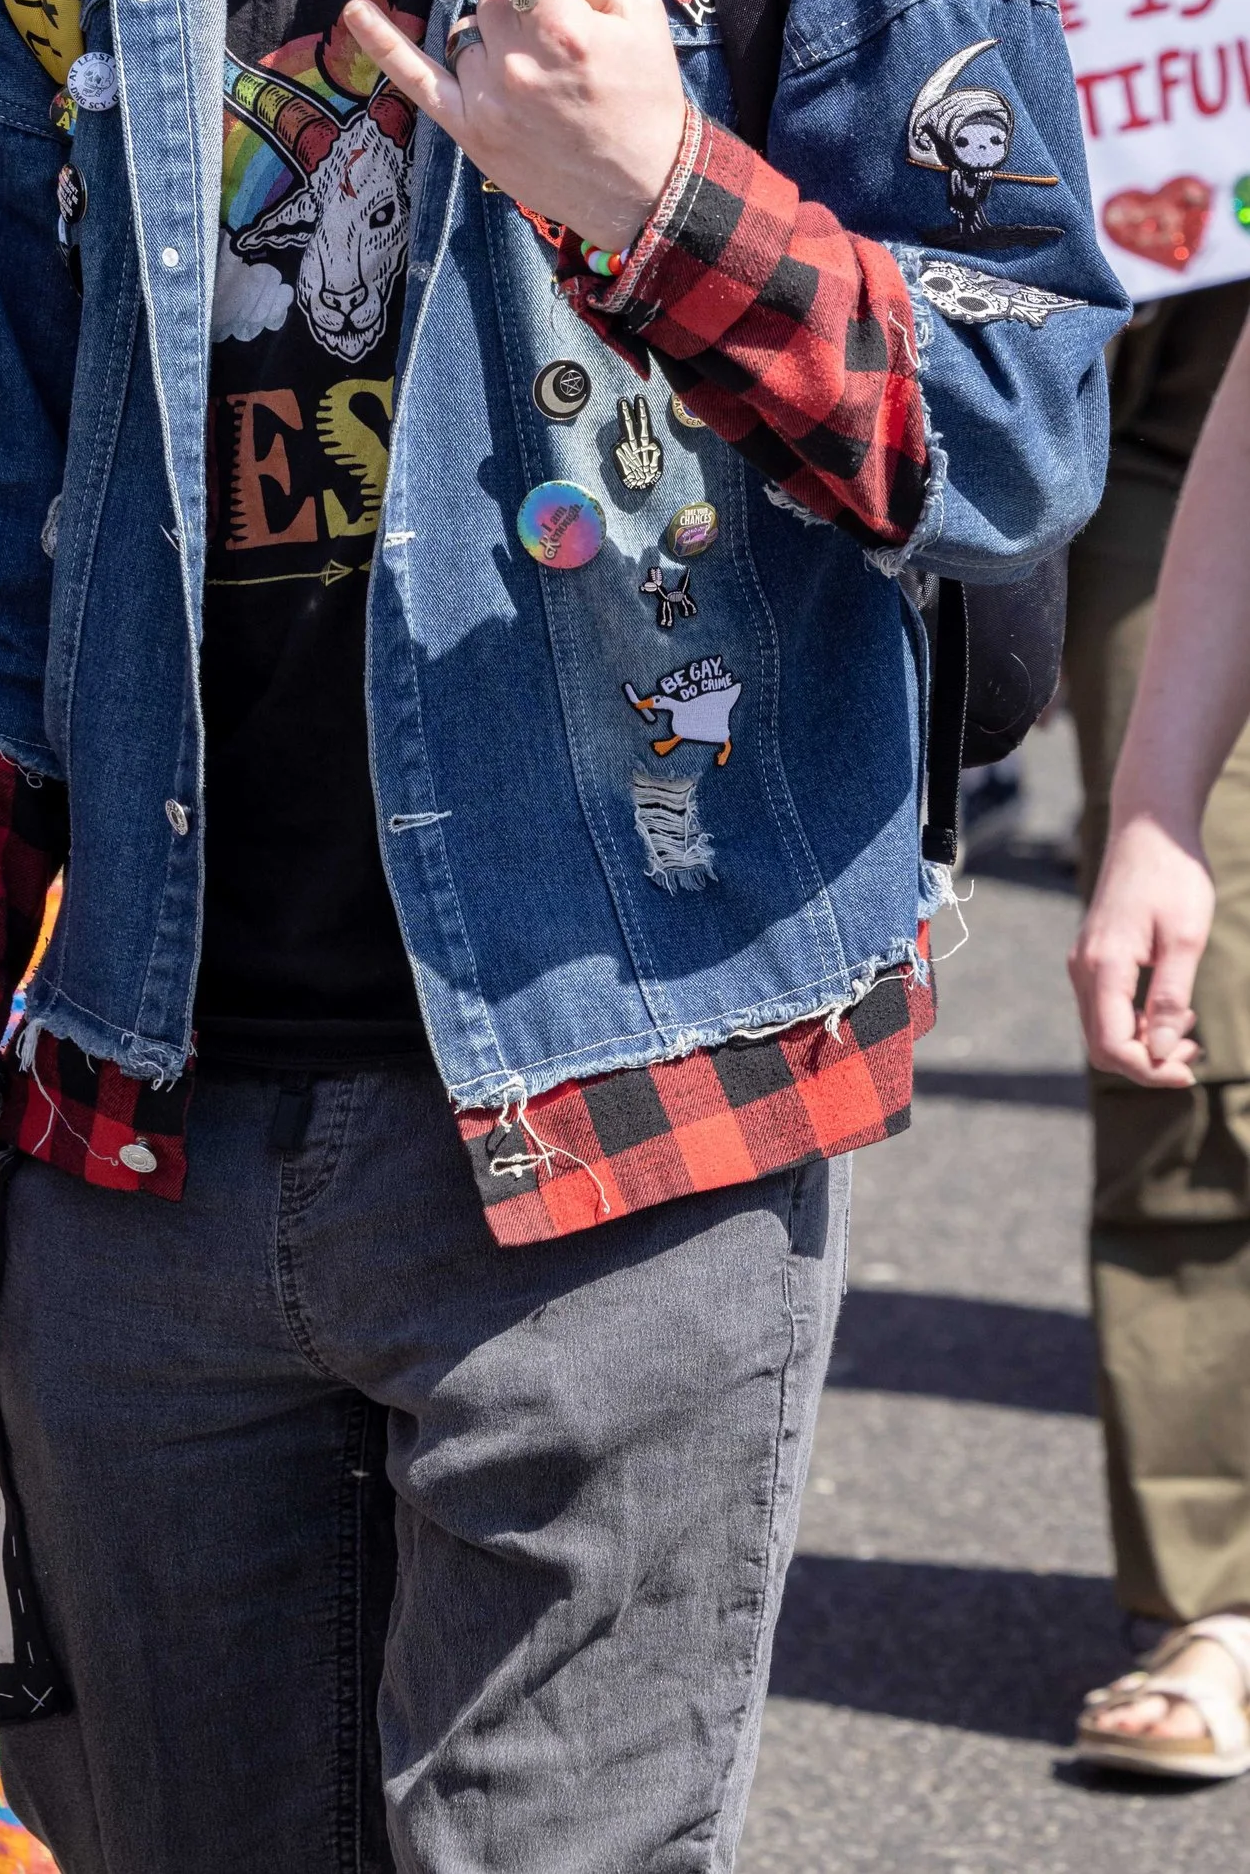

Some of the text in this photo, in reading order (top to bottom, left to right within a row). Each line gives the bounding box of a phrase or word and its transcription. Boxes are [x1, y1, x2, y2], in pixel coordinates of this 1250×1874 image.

[77, 53, 112, 67] LEAST
[208, 376, 395, 551] ES
[550, 506, 568, 525] am
[679, 511, 712, 526] CHANCES
[660, 669, 689, 694] BE
[679, 672, 733, 701] DO CRIME
